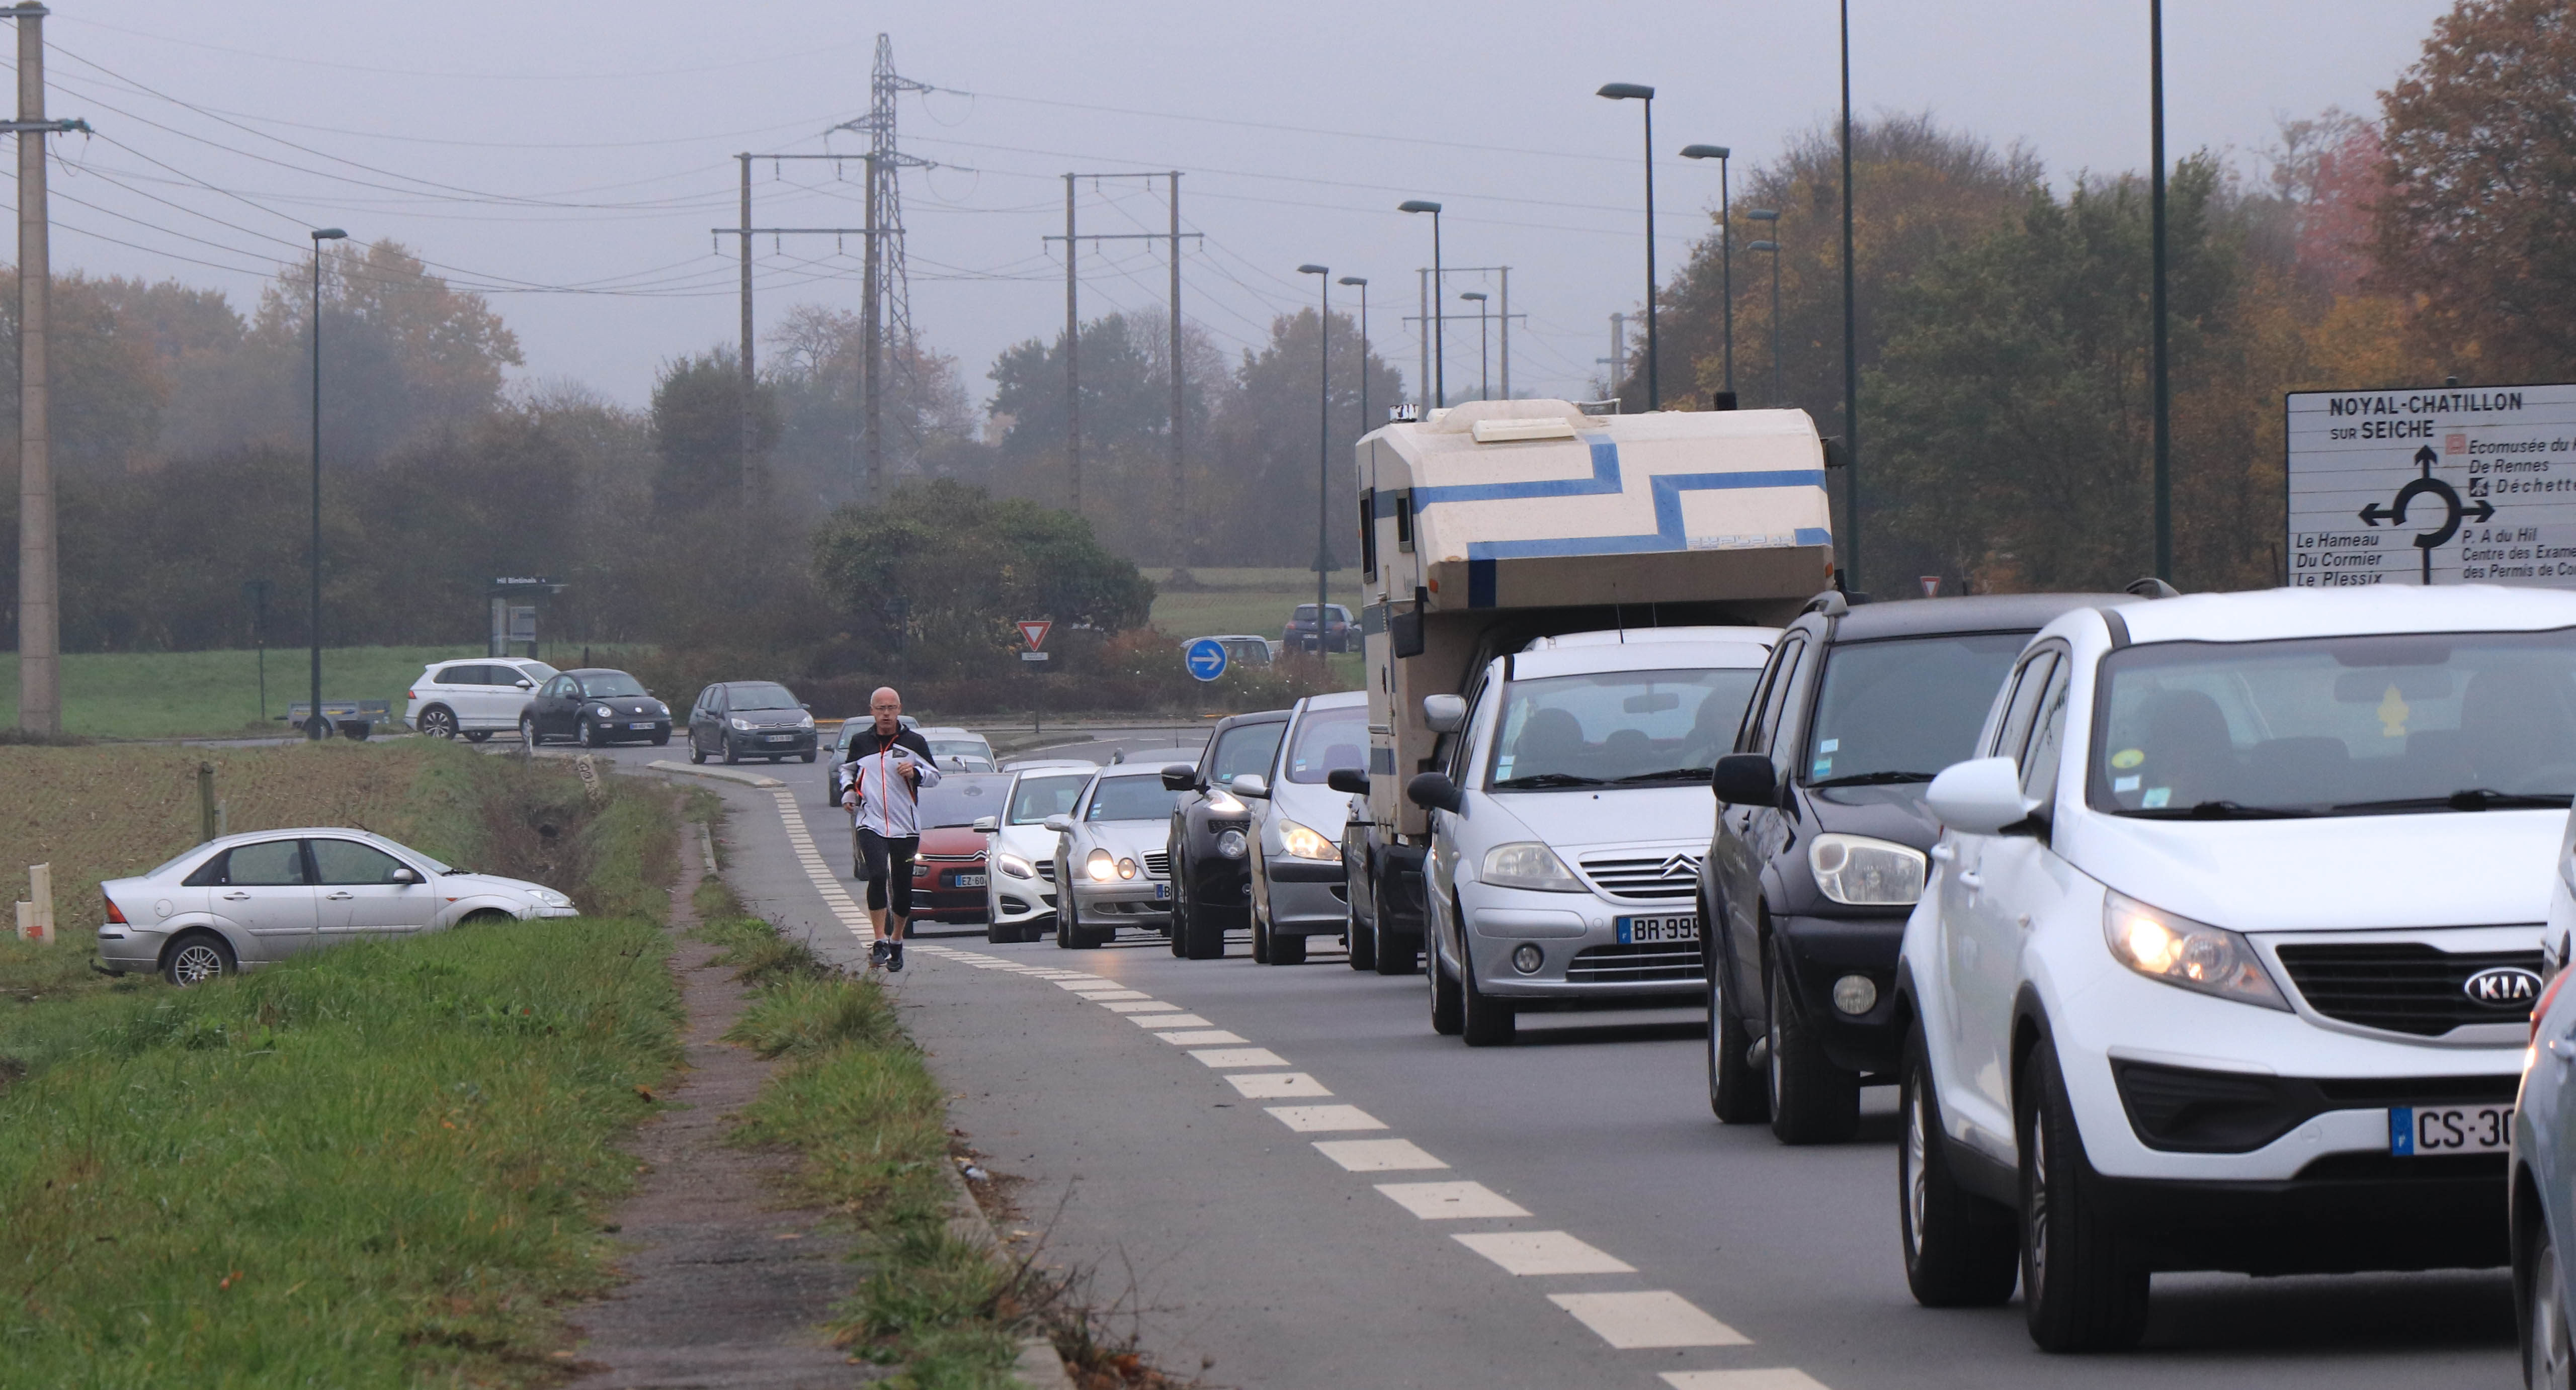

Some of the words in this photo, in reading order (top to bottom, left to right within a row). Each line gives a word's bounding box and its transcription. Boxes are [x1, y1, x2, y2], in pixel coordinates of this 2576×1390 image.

[2330, 393, 2522, 416] NOYAL-CHATILLON
[2331, 428, 2357, 440] SUR
[2361, 420, 2435, 439] SEICHE
[2468, 437, 2546, 455] Ecomusée
[2551, 437, 2569, 452] du
[2469, 460, 2490, 474] De
[2494, 458, 2549, 473] Rennes
[2296, 534, 2314, 549] Le
[2317, 533, 2379, 548] Hameau
[2496, 530, 2513, 543] du
[2517, 528, 2538, 542] Hil
[2297, 553, 2317, 568] Du
[2321, 551, 2382, 566] Cormier
[2462, 547, 2505, 561] Centre
[2509, 546, 2530, 559] des
[2297, 572, 2315, 587] Le
[2322, 570, 2382, 586] Plessix
[2463, 565, 2485, 579] des
[2490, 564, 2534, 578] Permis
[2538, 564, 2553, 576] de
[2479, 975, 2533, 999] KIA
